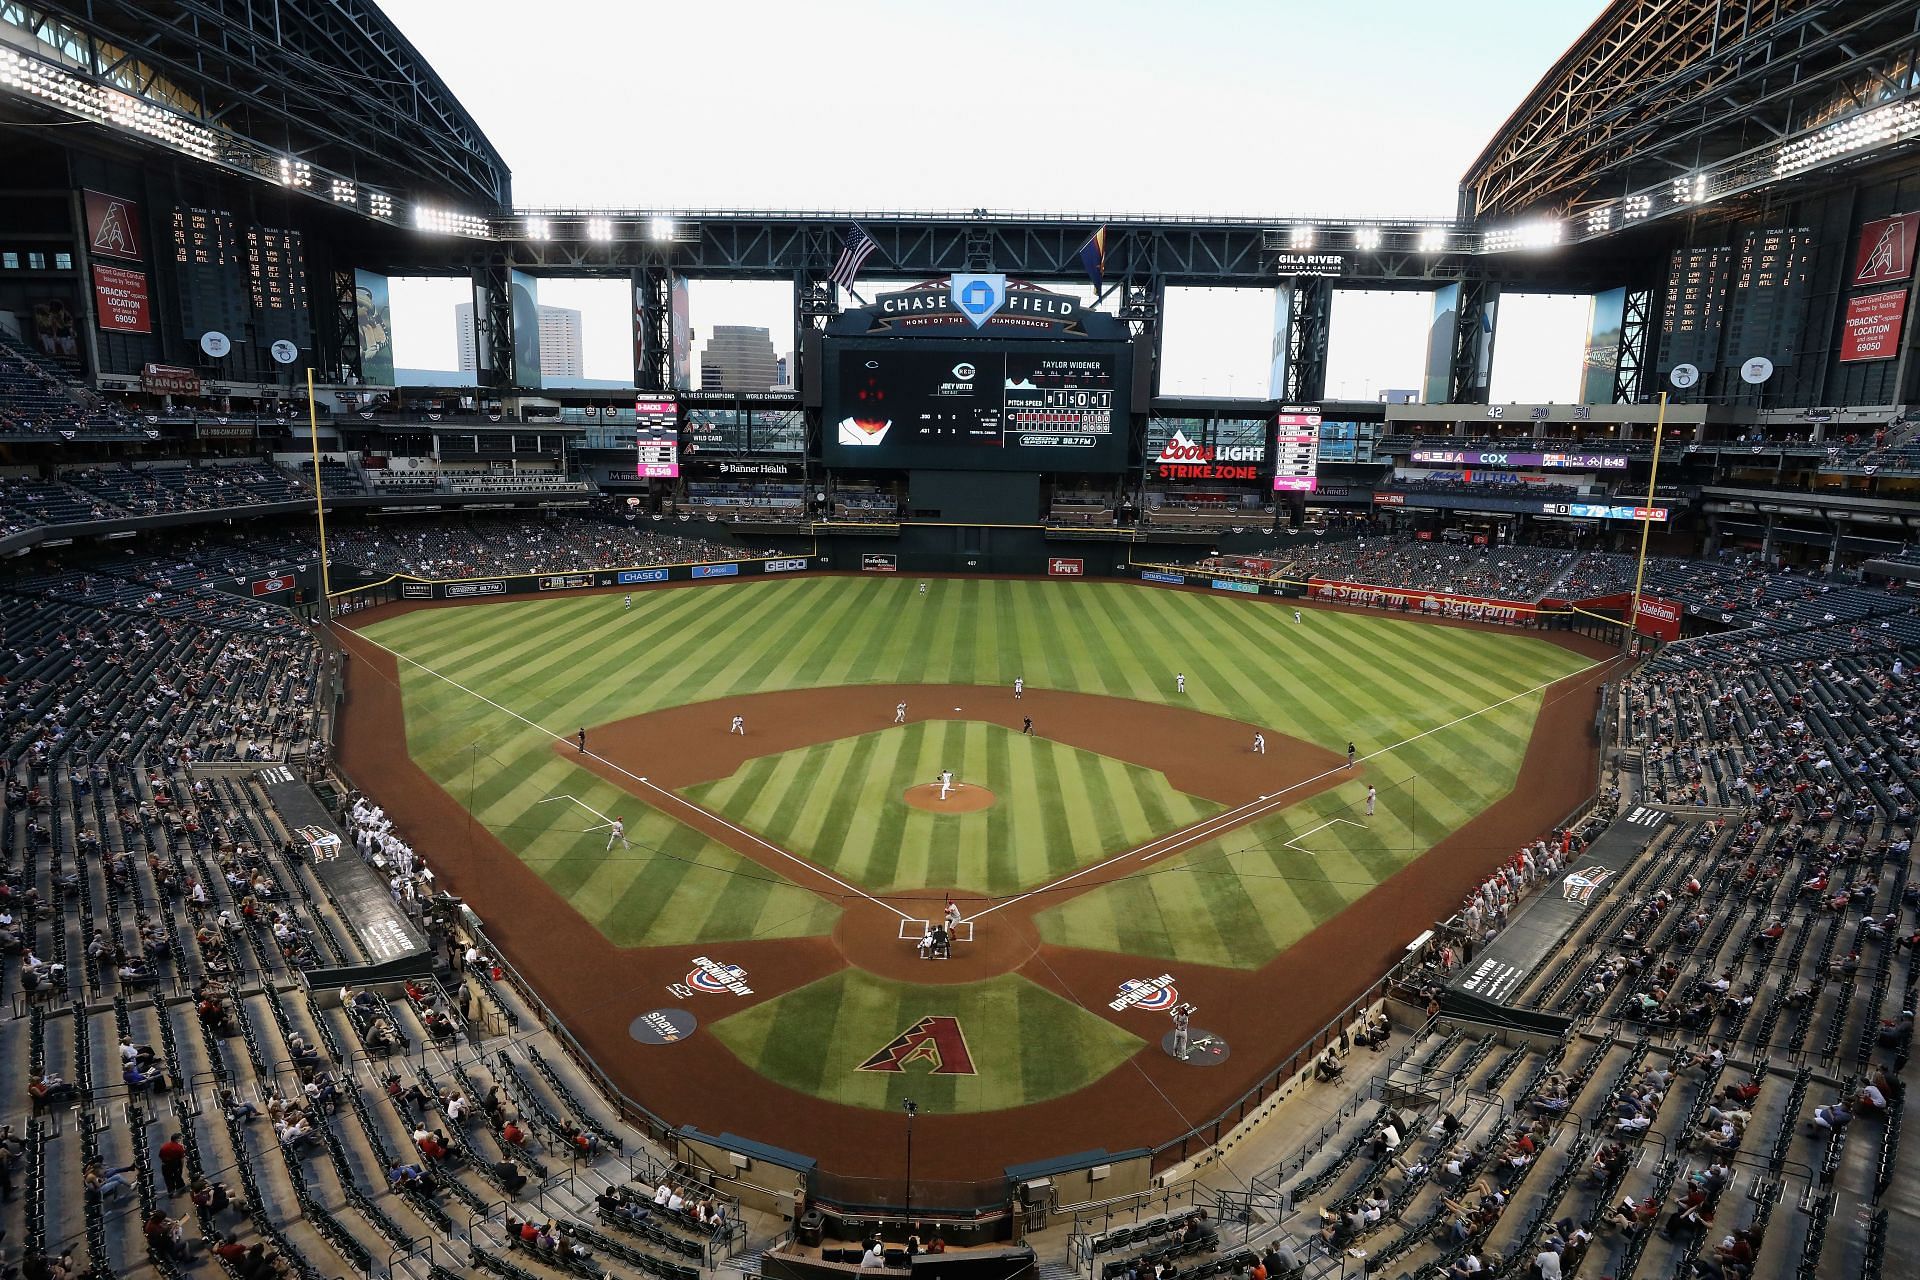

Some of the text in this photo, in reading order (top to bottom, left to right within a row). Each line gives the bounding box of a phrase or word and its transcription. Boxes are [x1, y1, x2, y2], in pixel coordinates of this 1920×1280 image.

[1278, 254, 1342, 264] GILA RIVER
[1741, 263, 1752, 271] 47
[1742, 273, 1750, 281] 19
[107, 297, 140, 309] LOCATION
[883, 295, 1073, 315] CHASE FIELD
[115, 314, 137, 324] 69050
[906, 318, 928, 326] HOME
[991, 318, 1049, 328] DIAMONDBACKS
[1853, 324, 1890, 337] LOCATION
[1857, 342, 1880, 352] 69050
[1043, 361, 1068, 369] TAYLOR
[146, 377, 199, 390] SANDLOT
[1047, 395, 1053, 403] B
[1058, 393, 1063, 405] 1
[1077, 394, 1086, 405] 0
[1101, 394, 1107, 406] 1
[1487, 407, 1503, 418] 42
[1530, 406, 1549, 419] 20
[1573, 406, 1590, 419] 51
[1161, 439, 1265, 461] Coors LIGHT
[1480, 453, 1507, 464] COX
[730, 464, 788, 474] Banner Health
[1159, 465, 1257, 479] STRIKE ZONE
[1428, 471, 1519, 483] Michelob ULTRA
[767, 561, 806, 571] GEICO
[1053, 560, 1079, 573] fry's
[624, 573, 654, 581] CHASE
[394, 932, 416, 951] RIVER
[691, 956, 755, 997] OPENING DAY
[1463, 958, 1498, 989] GILA RIVER
[1108, 973, 1176, 1012] OPENING DAY
[648, 1012, 681, 1035] shaw
